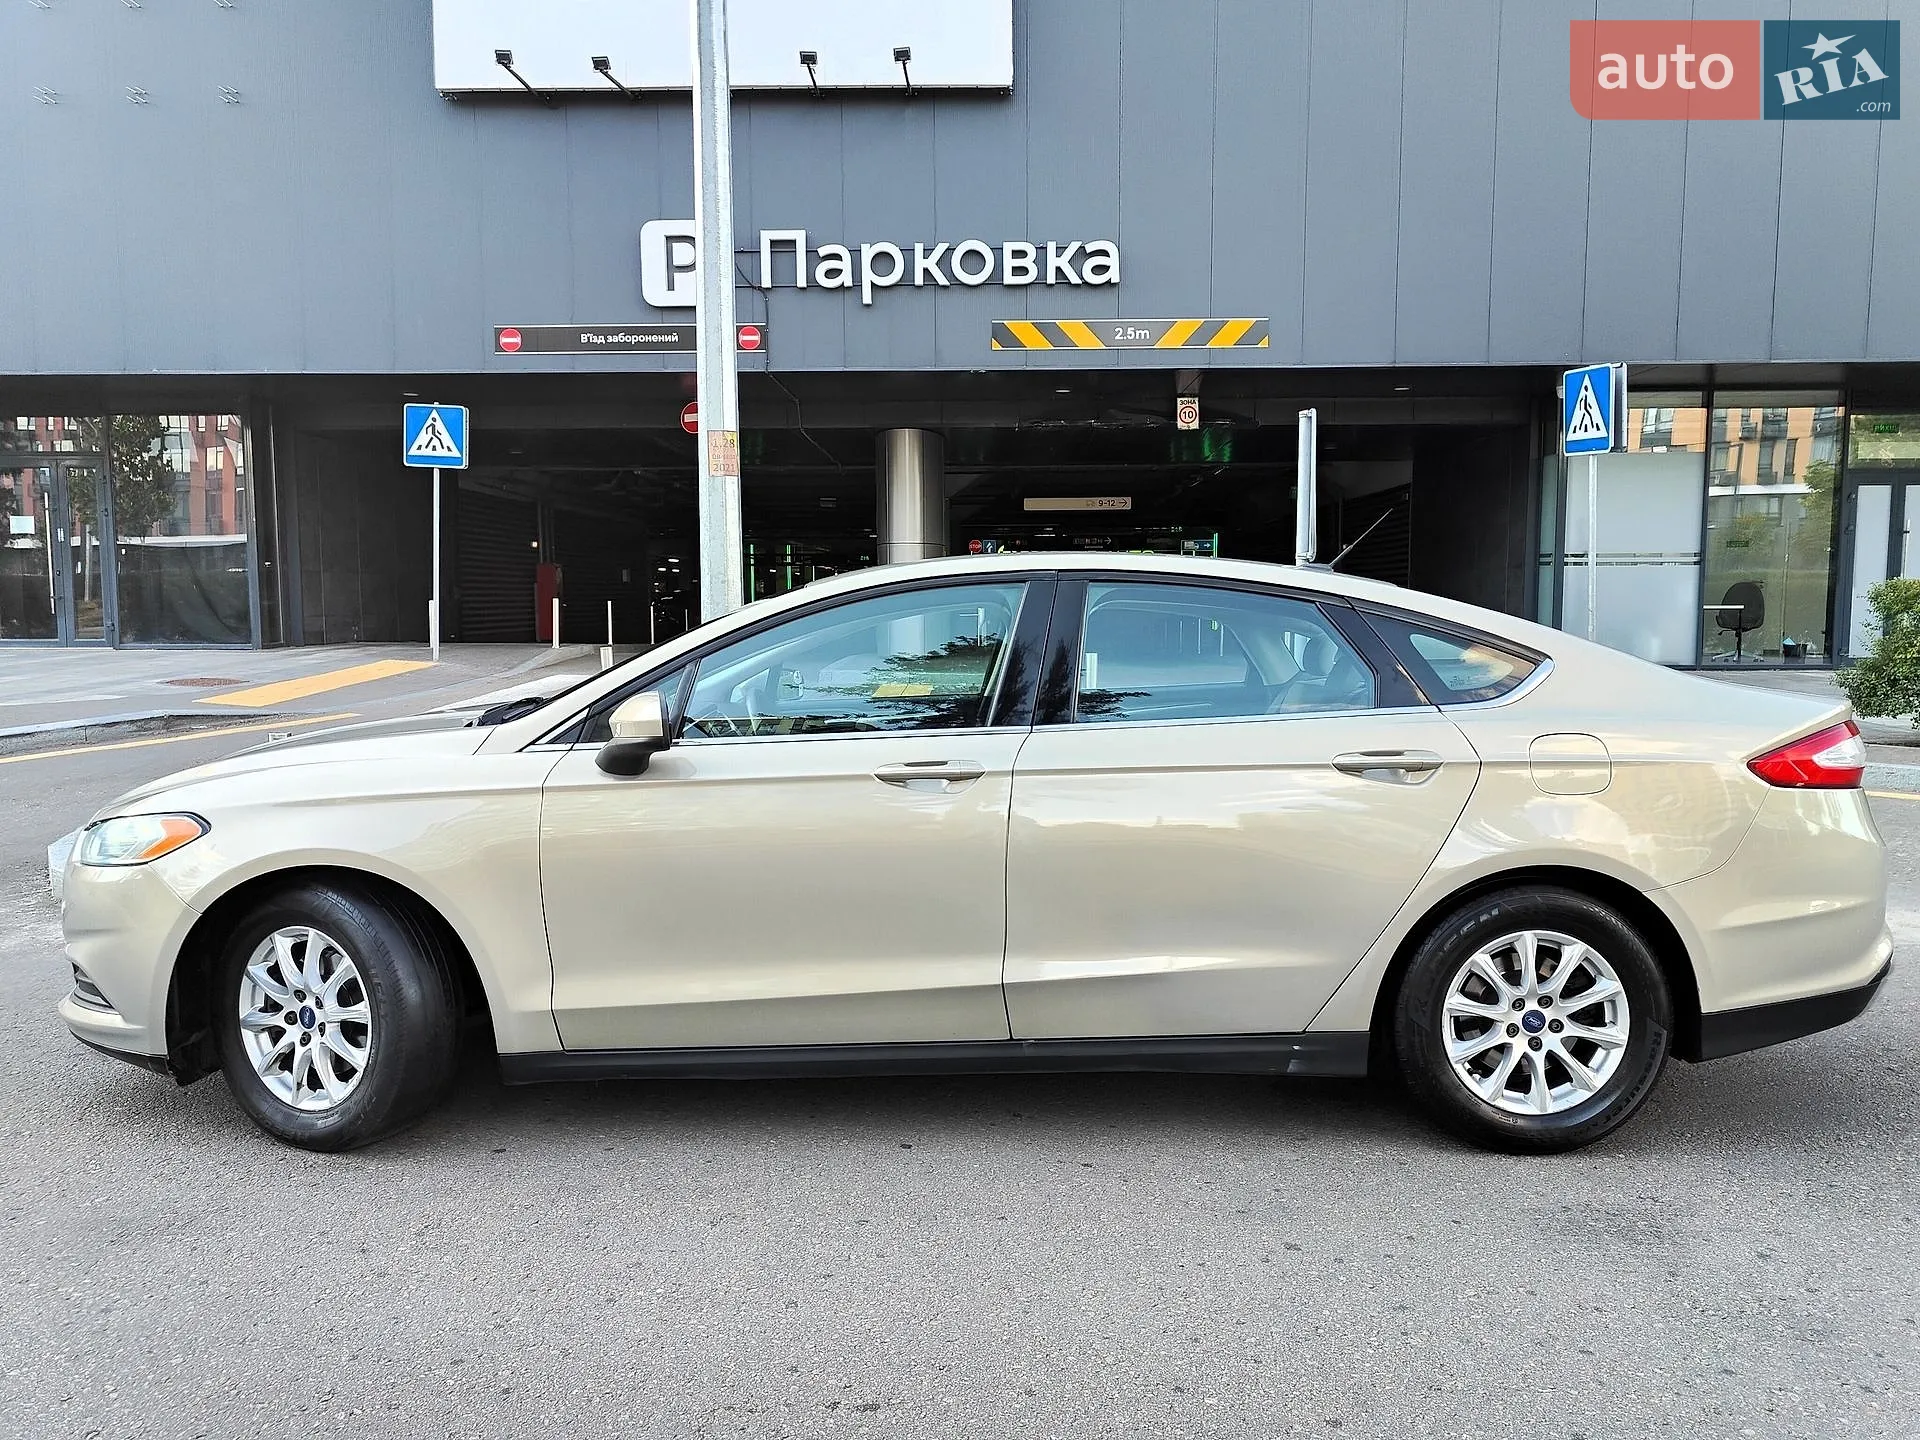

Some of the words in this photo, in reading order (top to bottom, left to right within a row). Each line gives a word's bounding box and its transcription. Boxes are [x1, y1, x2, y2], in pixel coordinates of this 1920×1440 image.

[760, 229, 1121, 305] Парковка
[606, 332, 679, 346] заборонений
[1114, 327, 1150, 340] 2.5m
[1182, 410, 1194, 420] 10
[713, 463, 736, 473] 2021
[1098, 499, 1116, 507] 9-12
